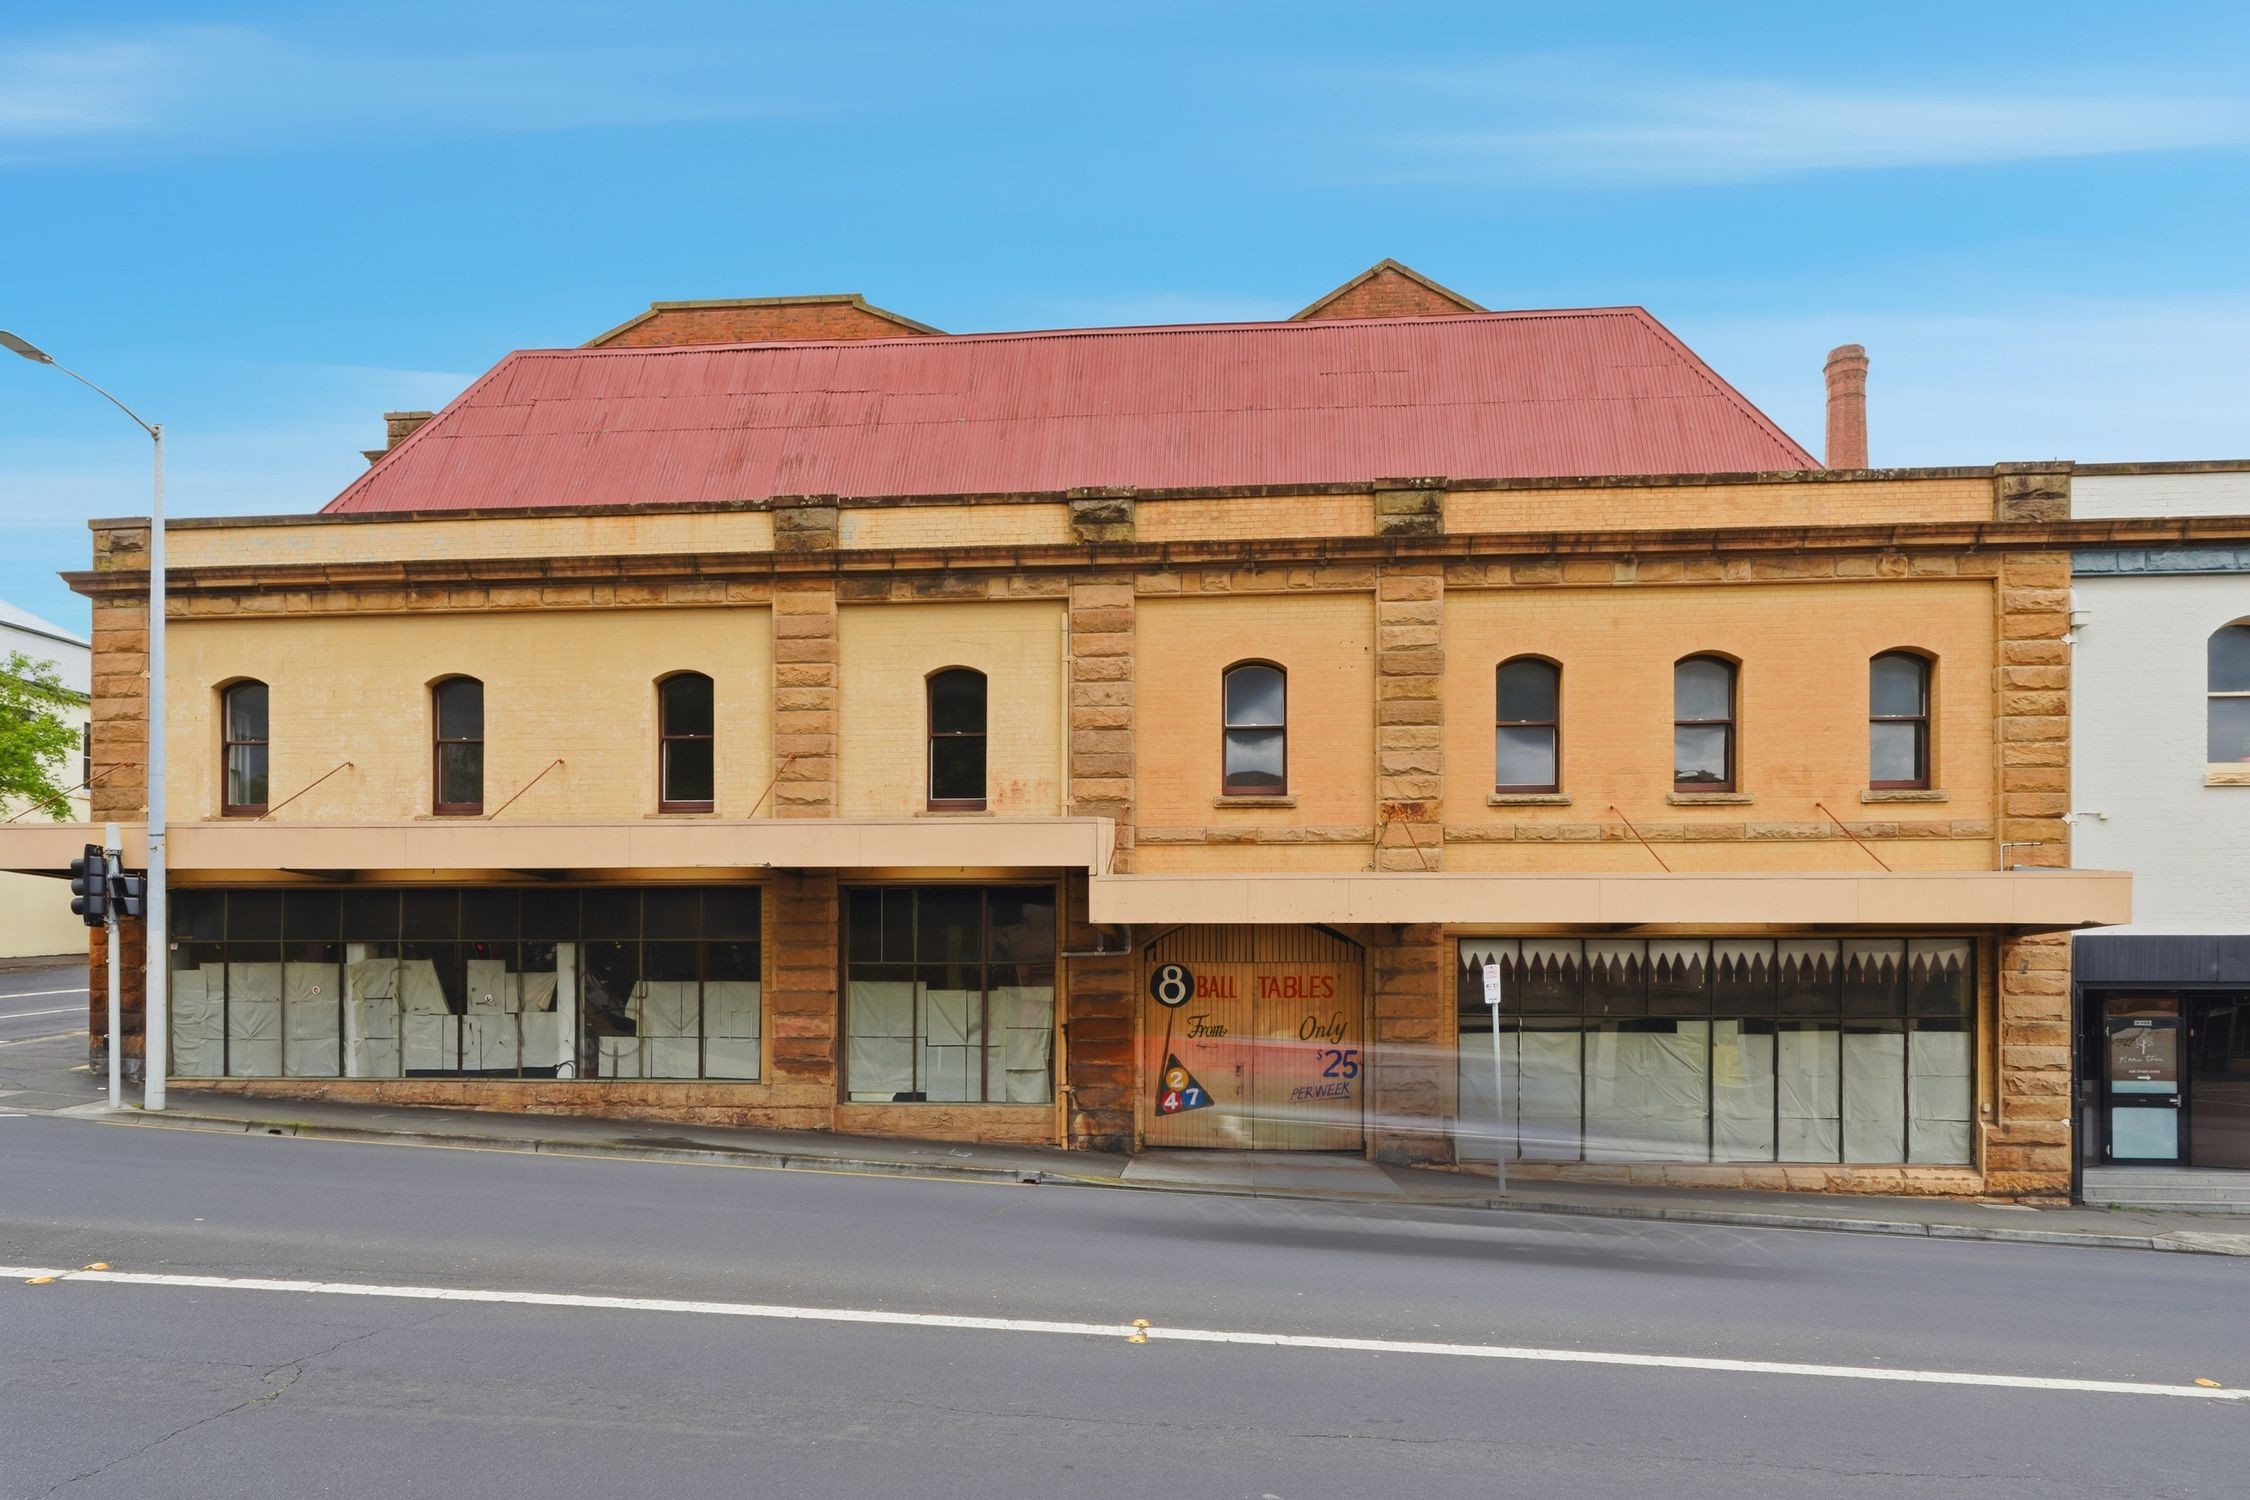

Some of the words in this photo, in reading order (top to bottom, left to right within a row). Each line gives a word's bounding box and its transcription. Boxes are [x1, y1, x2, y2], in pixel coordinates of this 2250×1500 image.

[1159, 965, 1186, 1004] 8
[1196, 975, 1237, 999] BALL
[1258, 975, 1334, 999] TABLES
[1187, 1014, 1228, 1039] From
[1300, 1011, 1348, 1044] Only
[1170, 1071, 1184, 1088] 2
[1185, 1088, 1200, 1106] 7
[1291, 1086, 1314, 1101] PER
[1315, 1081, 1350, 1096] WEEK
